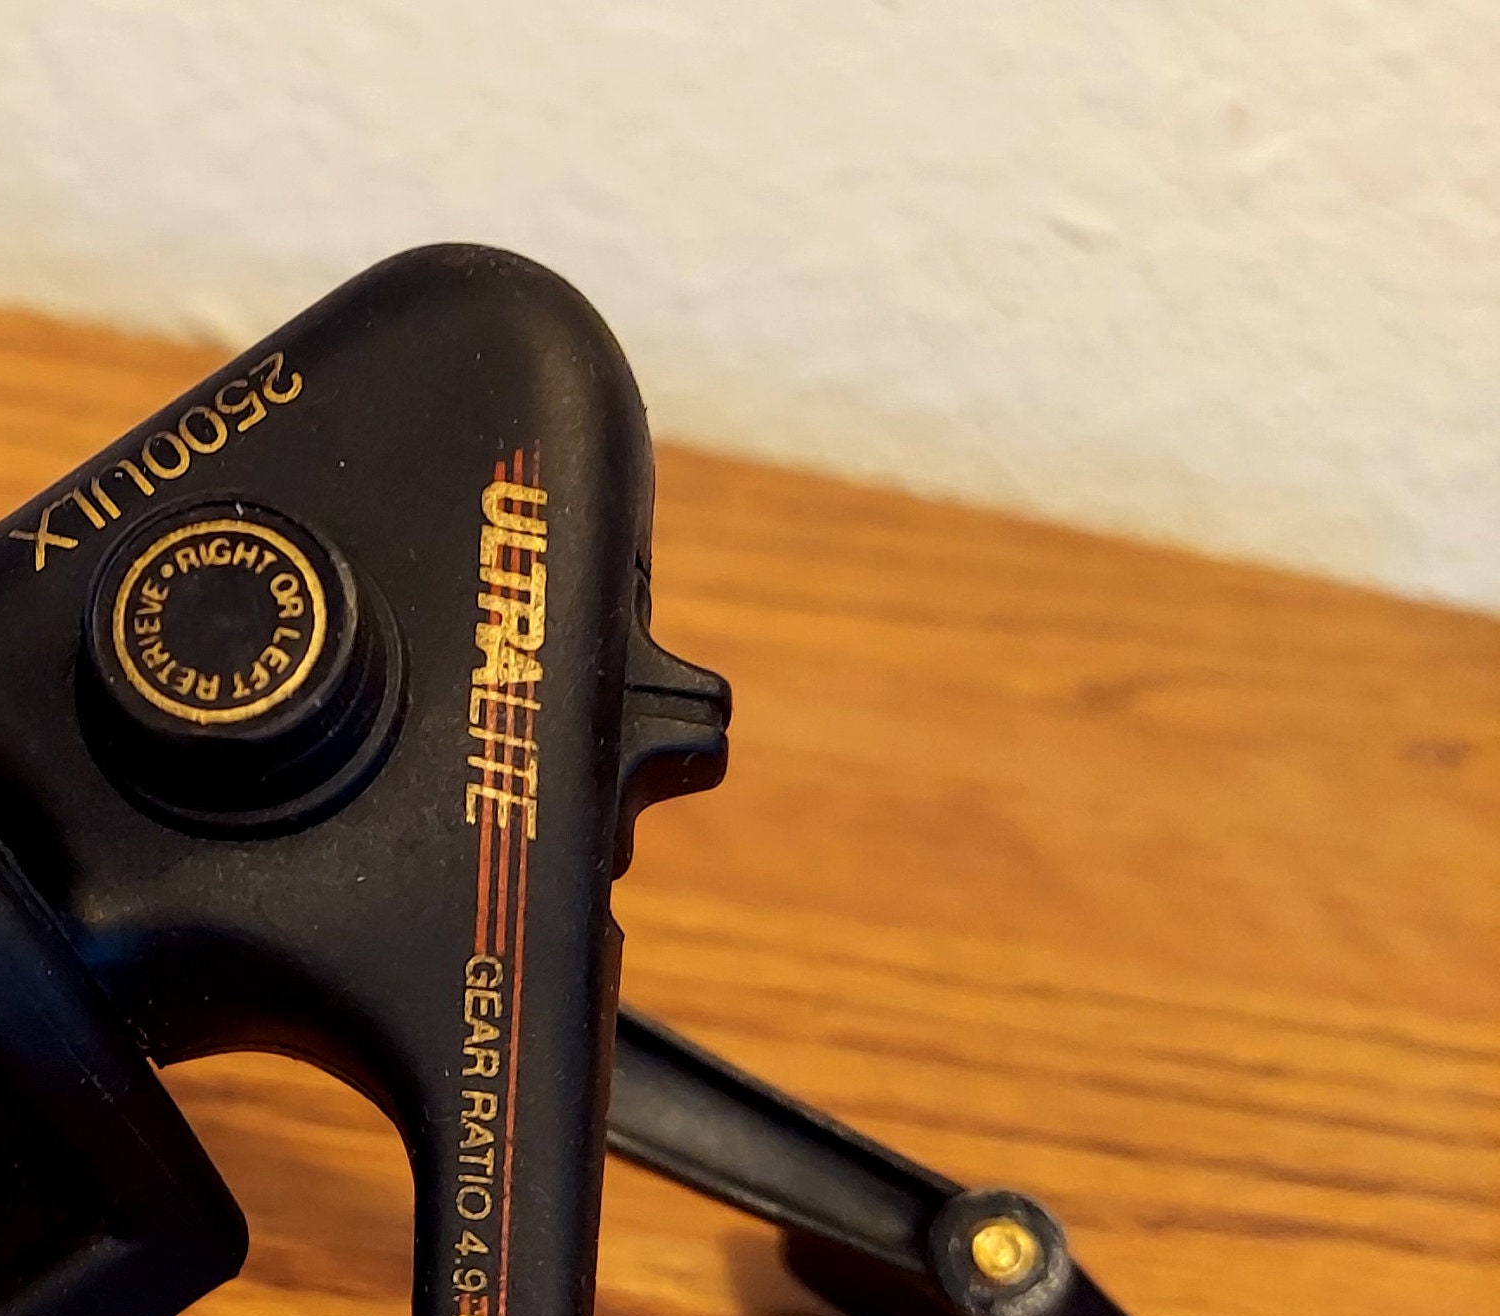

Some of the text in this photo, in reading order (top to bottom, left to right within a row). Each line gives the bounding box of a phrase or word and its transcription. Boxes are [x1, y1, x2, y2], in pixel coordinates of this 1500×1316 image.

[8, 352, 303, 571] 2500ULX
[134, 538, 304, 700] RIGHT OR LEFT RETRIEVE
[466, 481, 548, 839] ULTRALITE
[462, 954, 504, 1077] GEAR
[455, 1090, 498, 1222] RATIO
